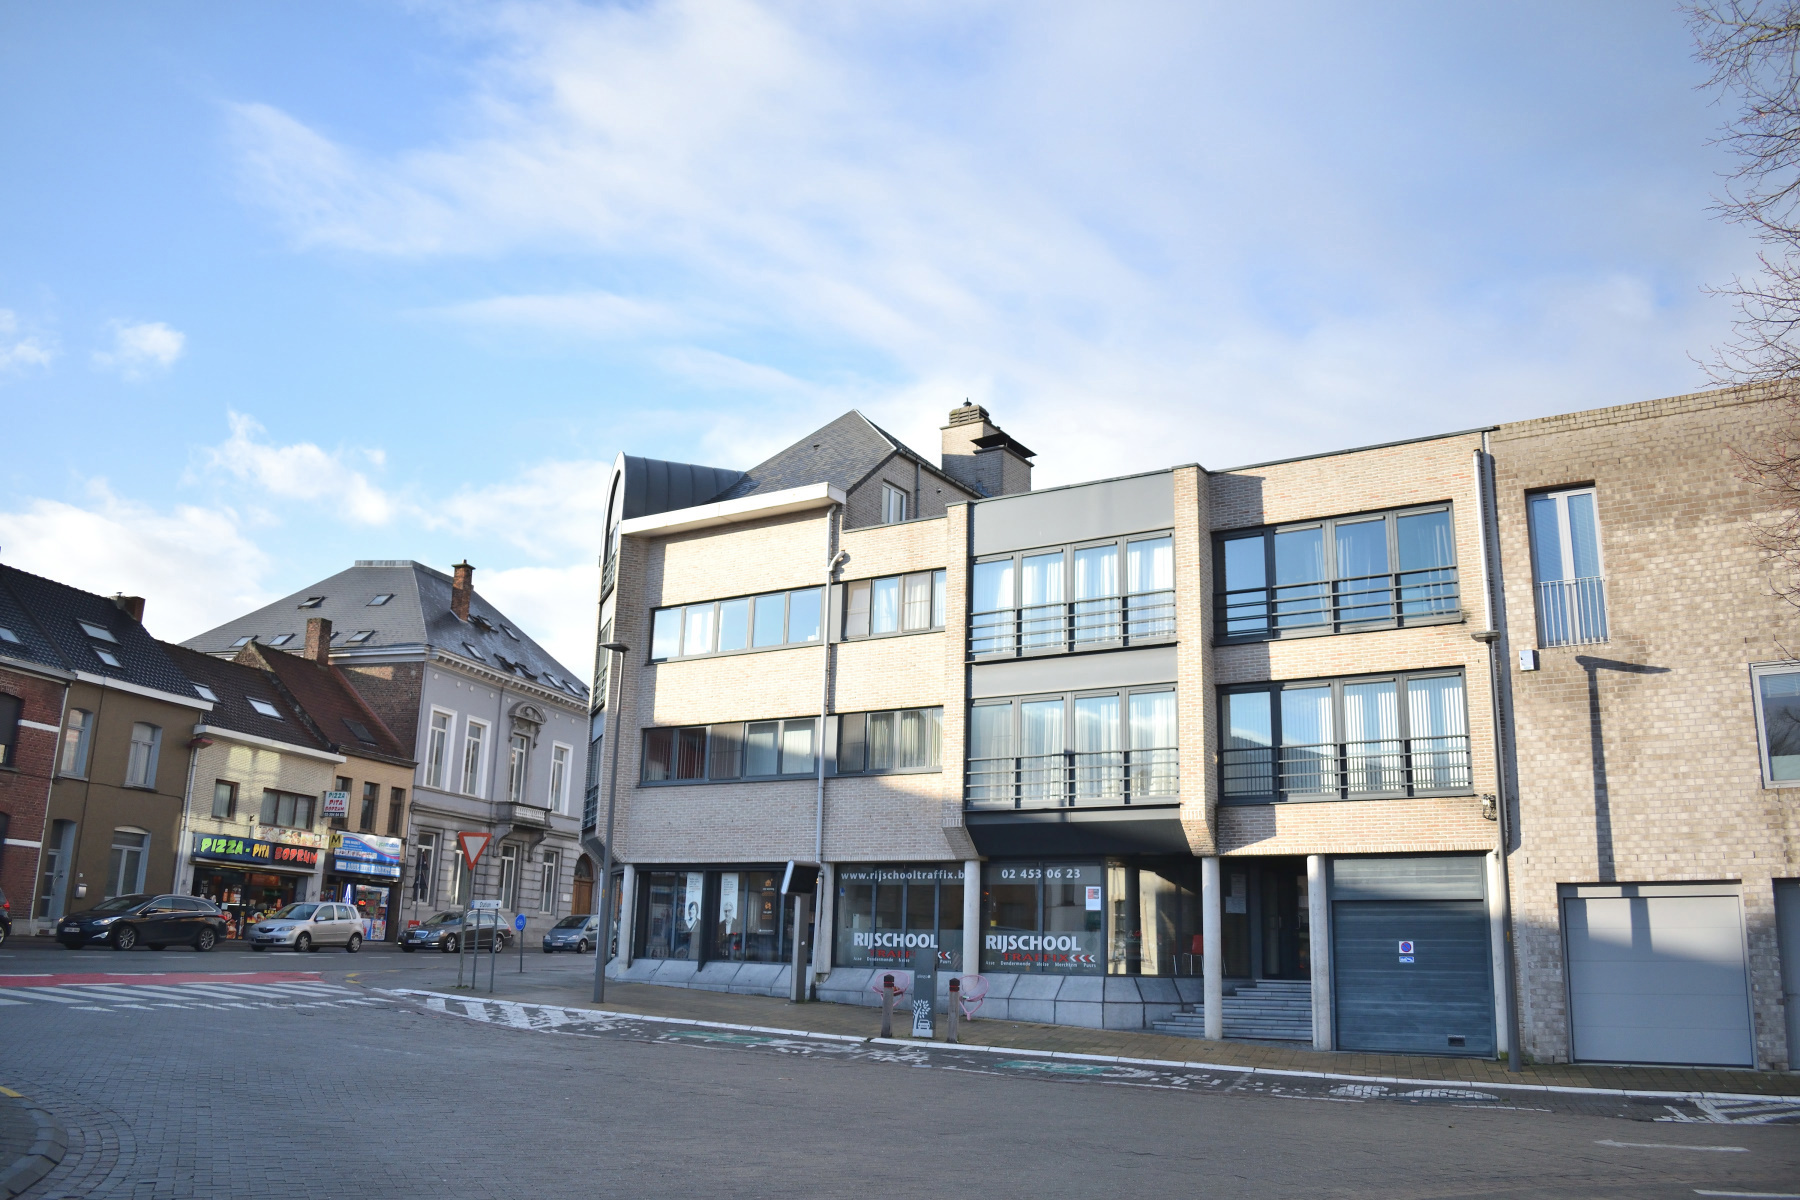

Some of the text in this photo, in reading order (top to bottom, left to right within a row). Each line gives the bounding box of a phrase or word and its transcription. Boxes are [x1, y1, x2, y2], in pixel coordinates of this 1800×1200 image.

[328, 791, 345, 799] PIZZA
[200, 838, 244, 855] PIZZA
[252, 843, 270, 859] PITA
[274, 847, 318, 865] BODRUM
[841, 870, 965, 882] www.rijschooltraffix.b
[1001, 869, 1081, 879] 02 453 06 23
[853, 932, 939, 949] RIJSCHOOL
[985, 935, 1082, 953] RIJSCHOOL
[869, 949, 916, 958] TRAFF
[1002, 953, 1069, 962] TRAFFIX
